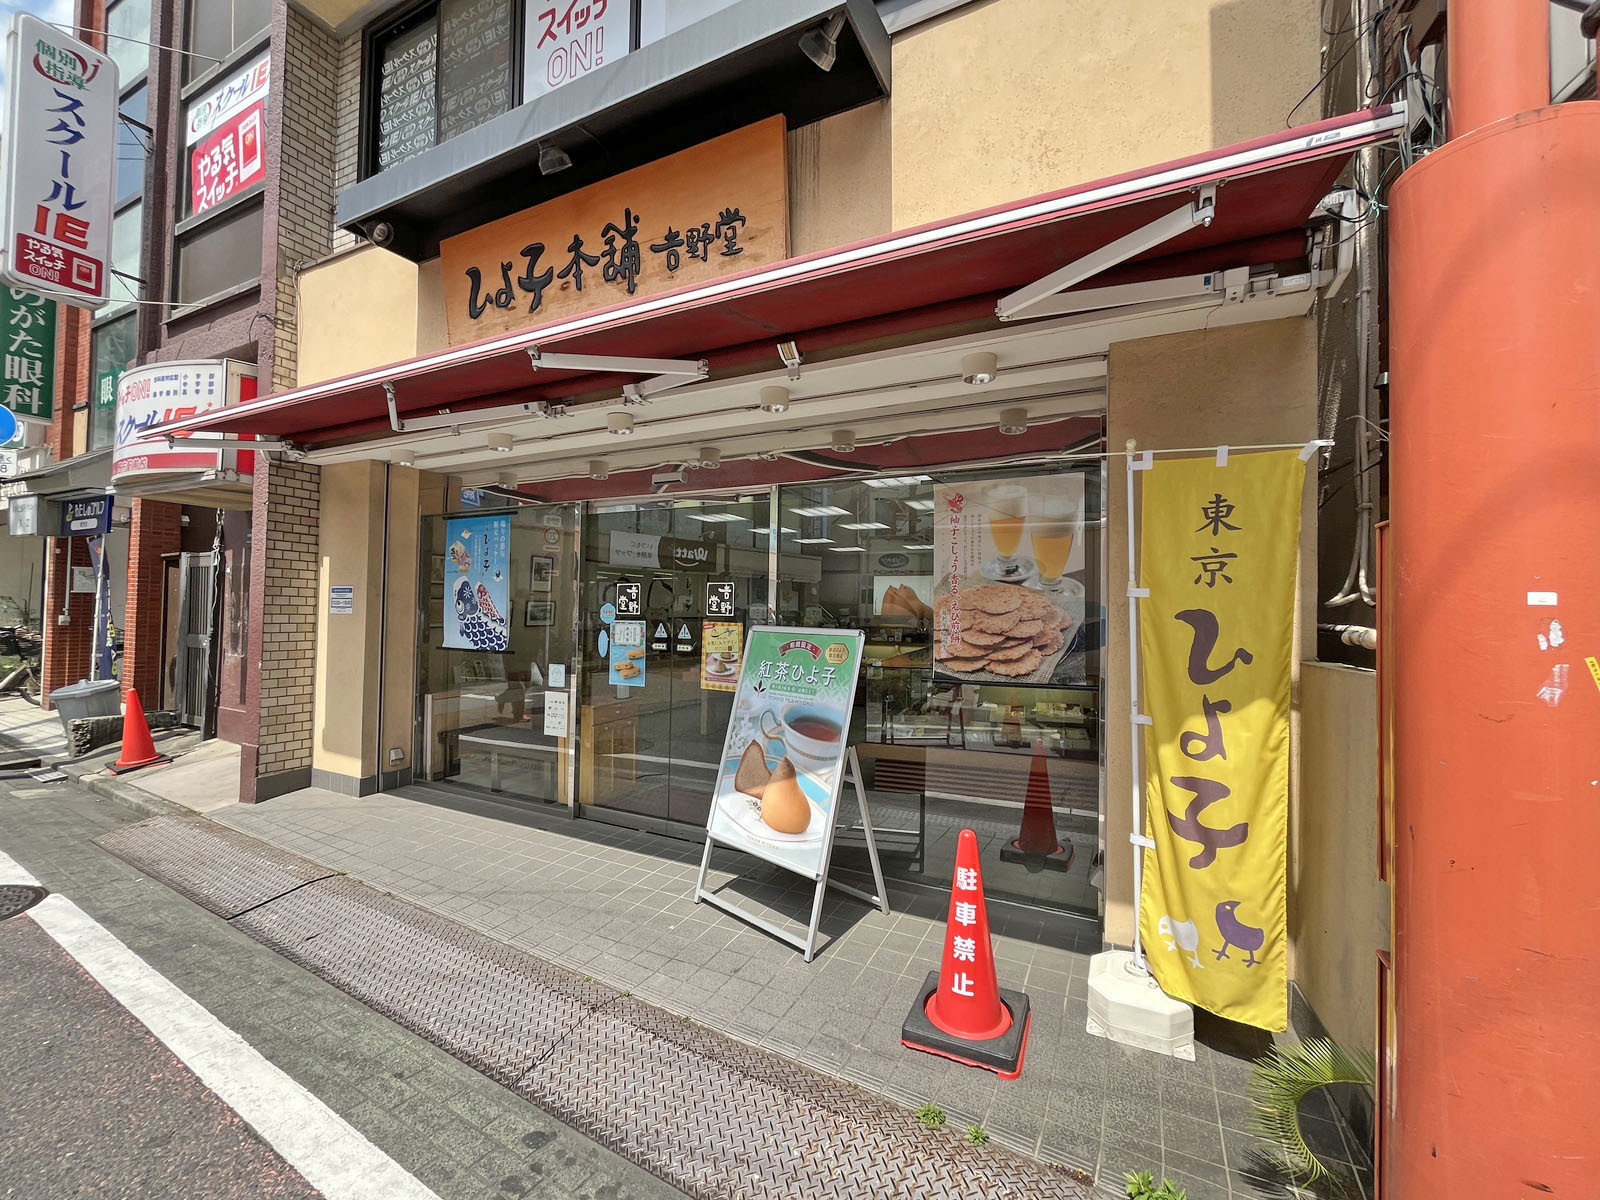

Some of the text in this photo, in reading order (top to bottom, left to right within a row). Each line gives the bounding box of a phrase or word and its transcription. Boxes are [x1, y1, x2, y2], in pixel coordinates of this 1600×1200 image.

[35, 39, 77, 71] 個別
[547, 26, 604, 87] ON!
[197, 133, 236, 186] やる気
[196, 161, 239, 214] スイッチ
[26, 238, 64, 260] やる気
[34, 204, 90, 250] IE
[23, 249, 67, 270] スイッチ
[29, 264, 60, 282] ON!
[465, 207, 747, 320] ひよ子本舗 吉野堂
[758, 660, 837, 687] 紅茶ひよ子
[951, 866, 978, 997] 駐車禁止
